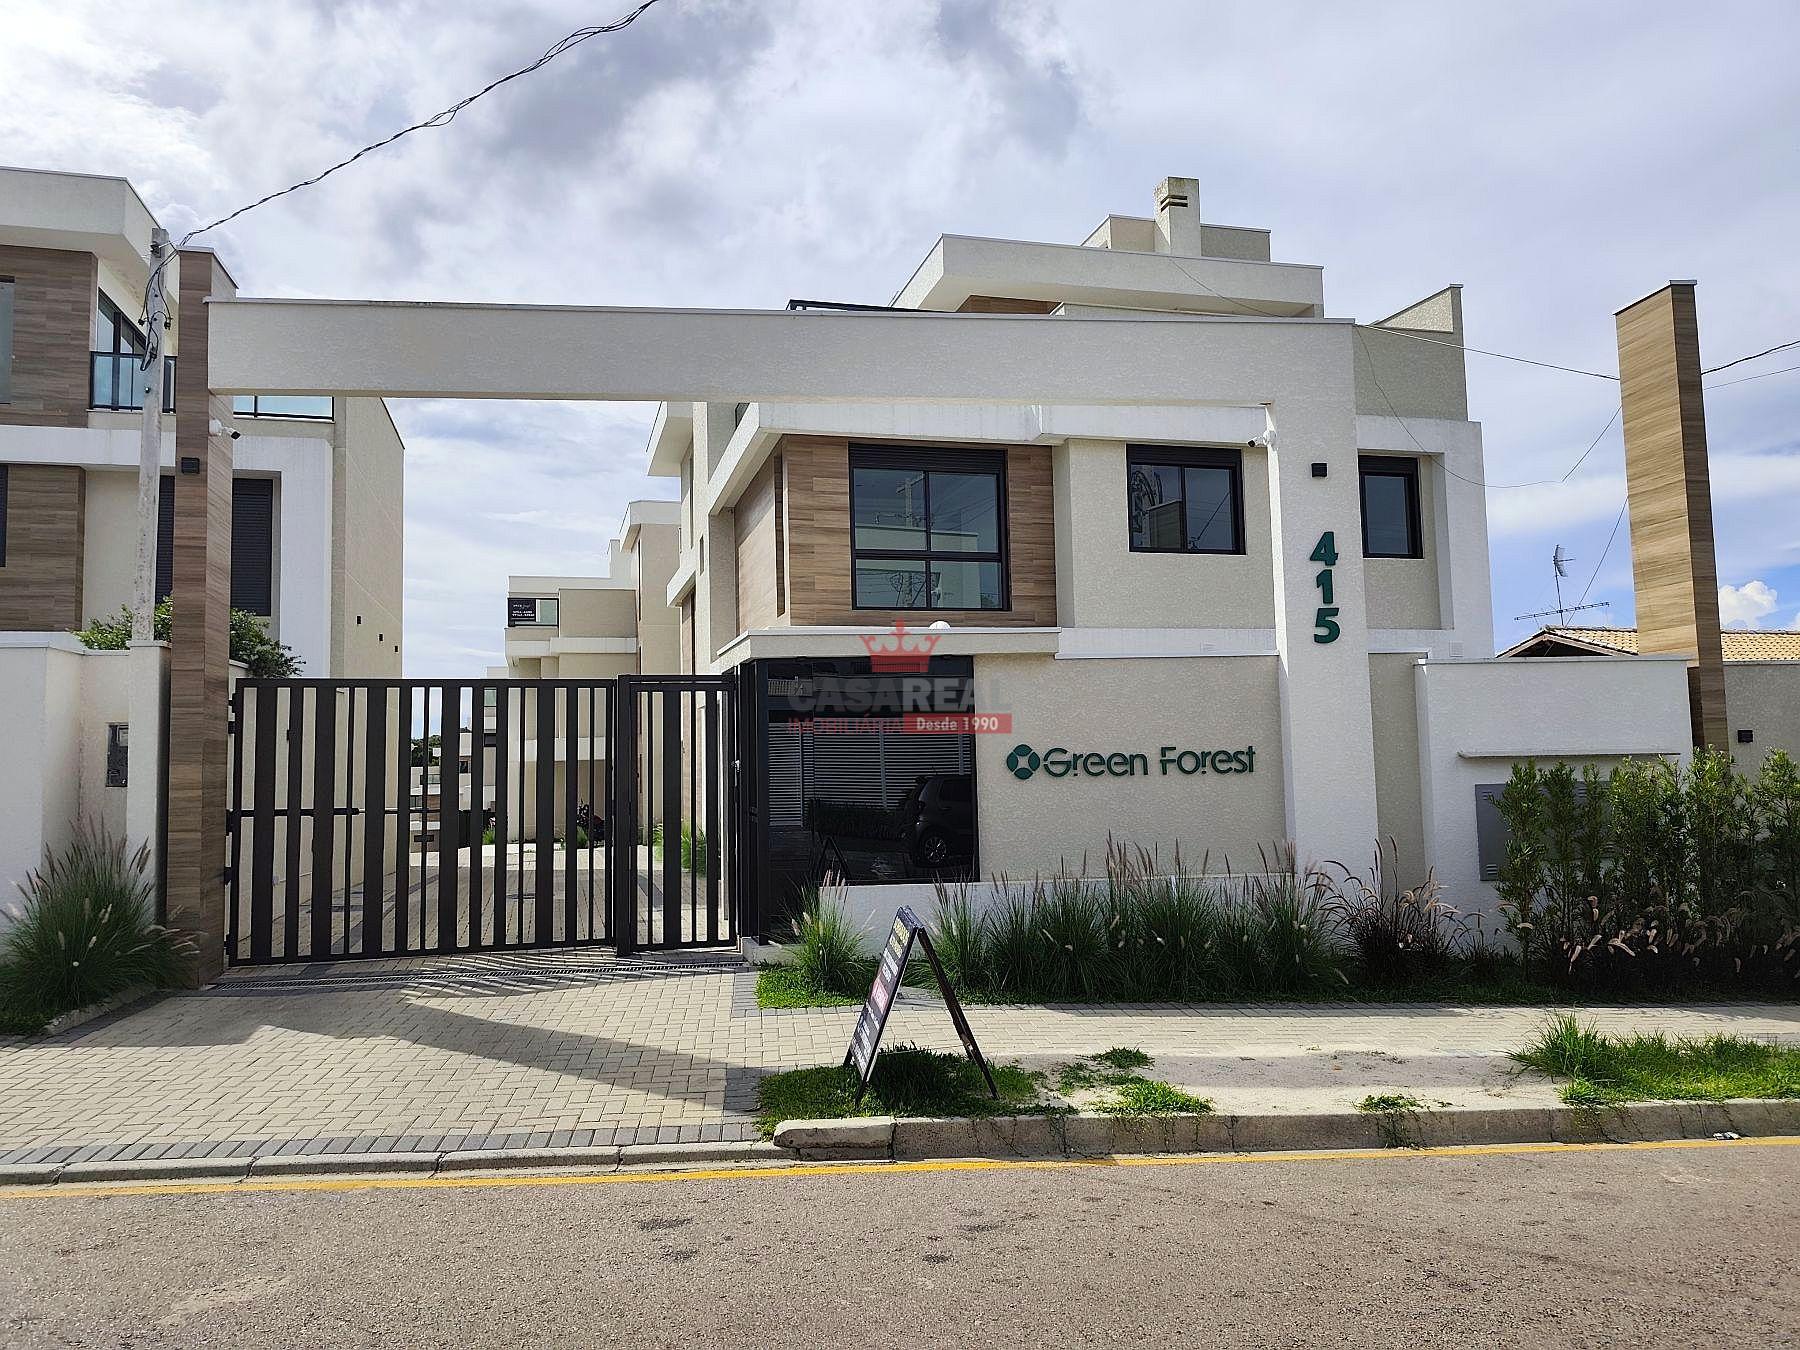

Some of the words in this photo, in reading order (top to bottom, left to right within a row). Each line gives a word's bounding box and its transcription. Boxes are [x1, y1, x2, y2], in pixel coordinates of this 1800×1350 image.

[1310, 531, 1340, 643] 415
[1043, 747, 1148, 777] Green
[1160, 746, 1256, 775] Forest
